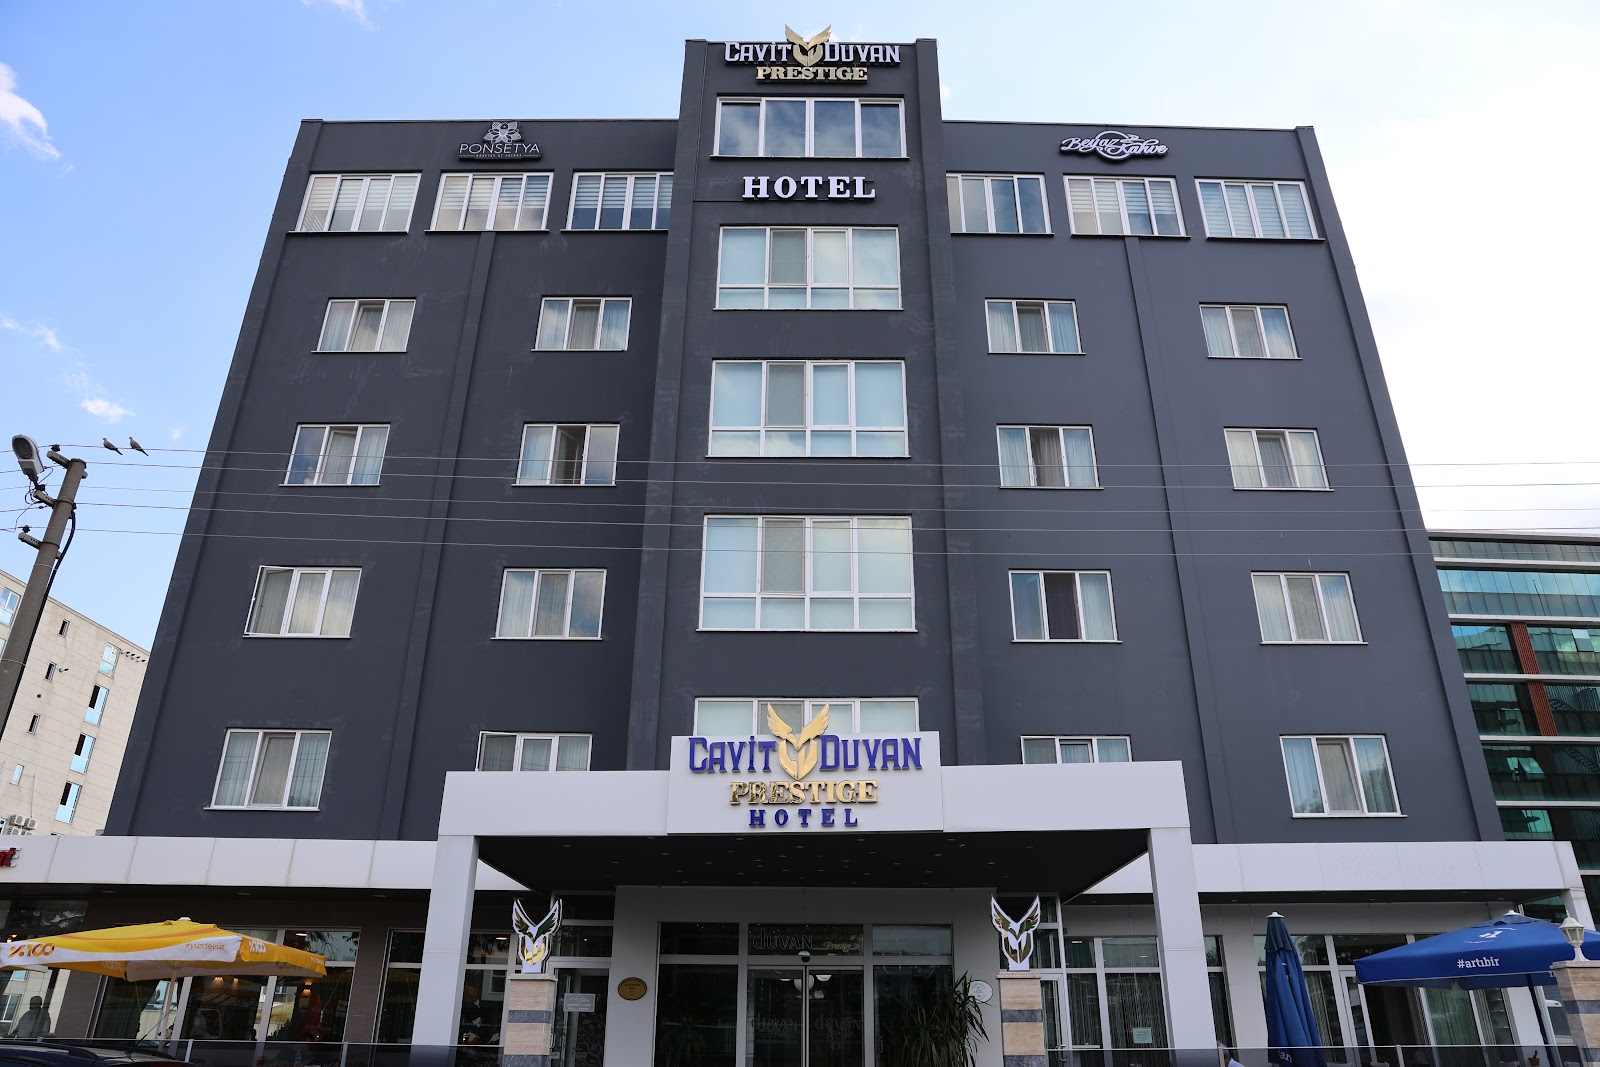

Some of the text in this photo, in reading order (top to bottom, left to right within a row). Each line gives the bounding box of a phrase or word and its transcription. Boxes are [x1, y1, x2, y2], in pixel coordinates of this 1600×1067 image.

[824, 42, 901, 63] DUVAN
[756, 66, 868, 81] PRESTIGE
[459, 143, 540, 154] PONSETYA
[1061, 137, 1169, 155] Beyaz Kahve
[742, 176, 876, 198] HOTEL
[688, 734, 923, 773] CAVİT DUVAN
[729, 779, 879, 805] PRESTIGE
[748, 808, 858, 828] HOTEL
[7, 943, 55, 959] %100
